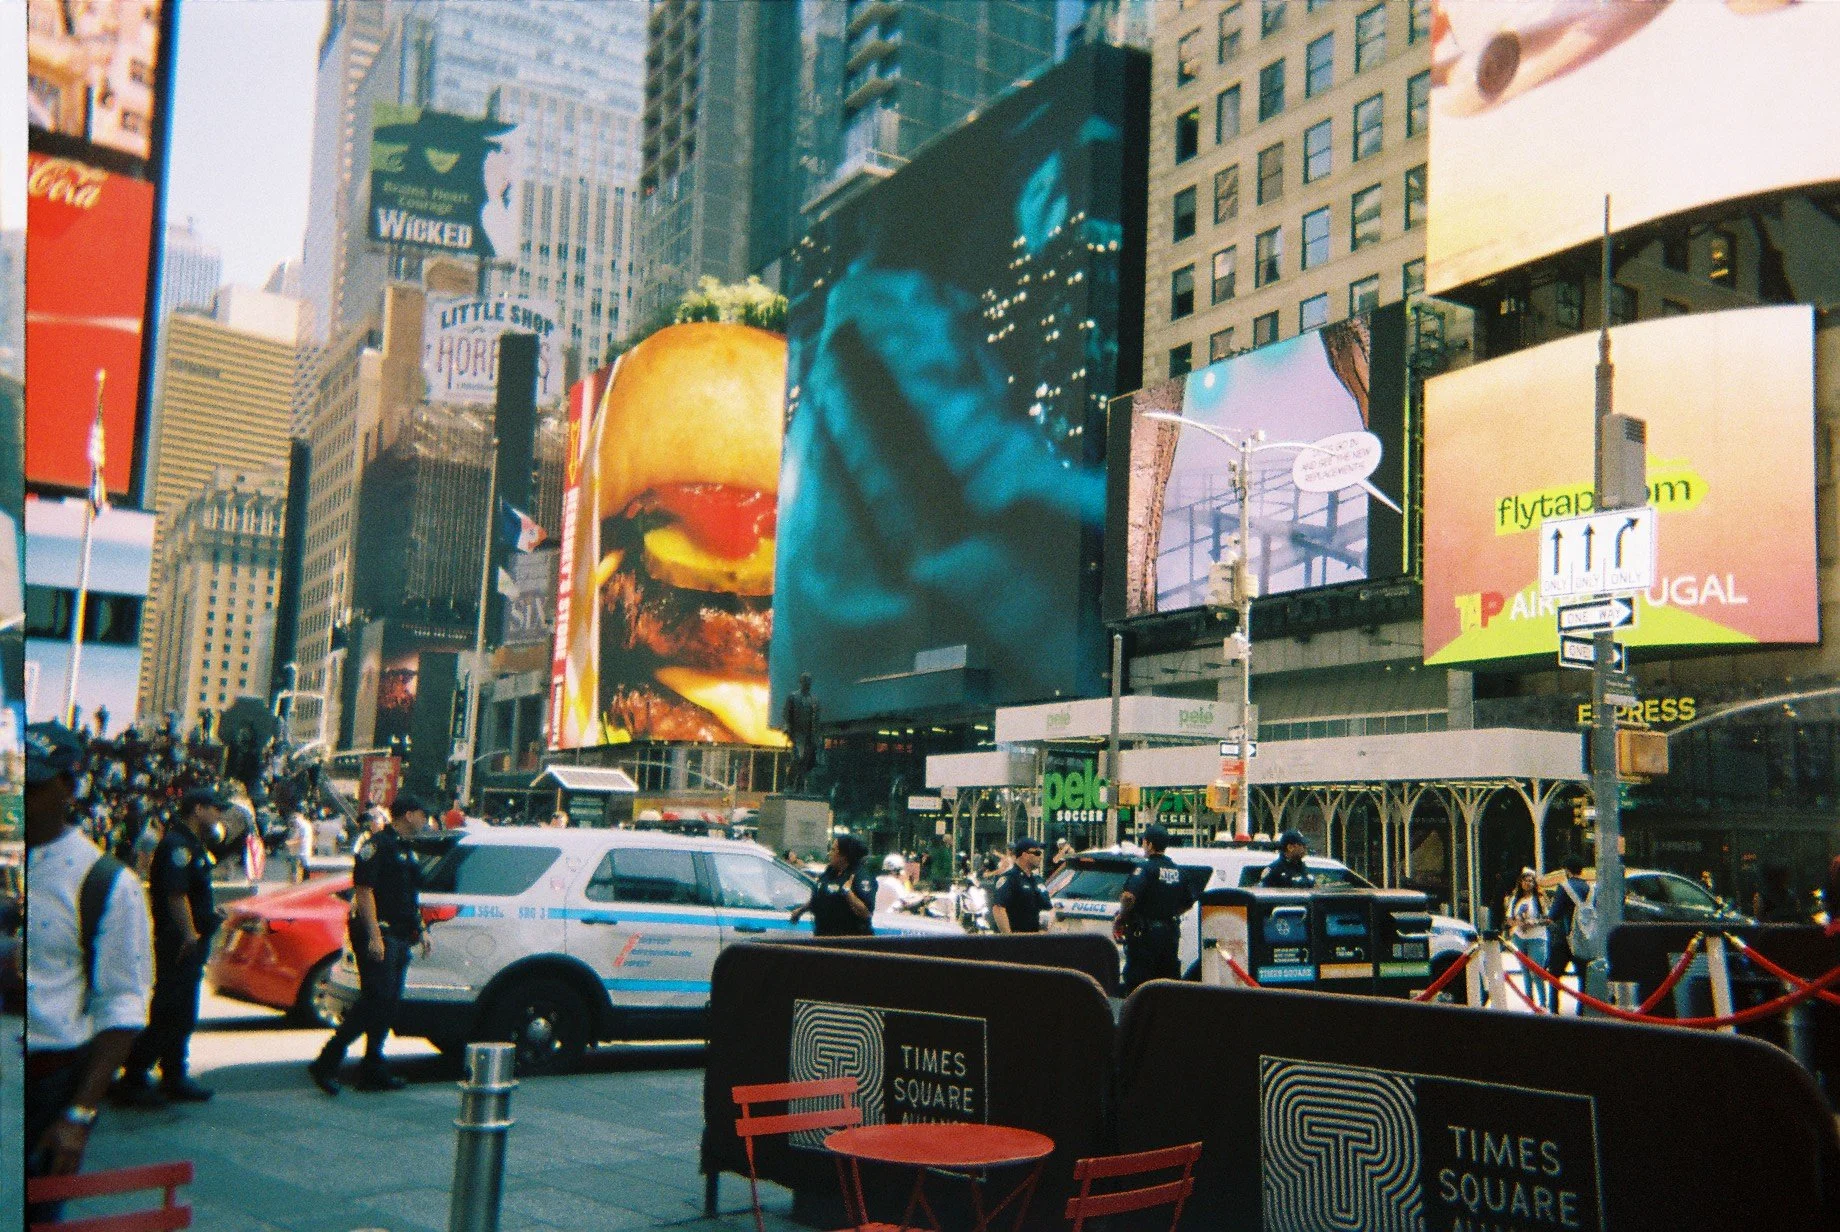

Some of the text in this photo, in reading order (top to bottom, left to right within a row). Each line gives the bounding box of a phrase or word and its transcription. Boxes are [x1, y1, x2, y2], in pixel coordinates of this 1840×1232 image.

[441, 302, 555, 337] LITTLE SHOP
[1544, 579, 1567, 592] ONLY
[1575, 574, 1601, 589] ONLY
[1611, 571, 1642, 585] ONLY
[1567, 608, 1621, 624] ONE WAY
[1568, 644, 1588, 658] ONE
[1577, 697, 1696, 724] EPRESS
[1056, 810, 1104, 822] SOCCER
[1072, 902, 1107, 913] POLICE
[901, 1045, 967, 1076] TIMES
[894, 1077, 974, 1113] SQUARE
[1448, 1125, 1561, 1176] TIMES
[1439, 1168, 1580, 1227] SQUARE
